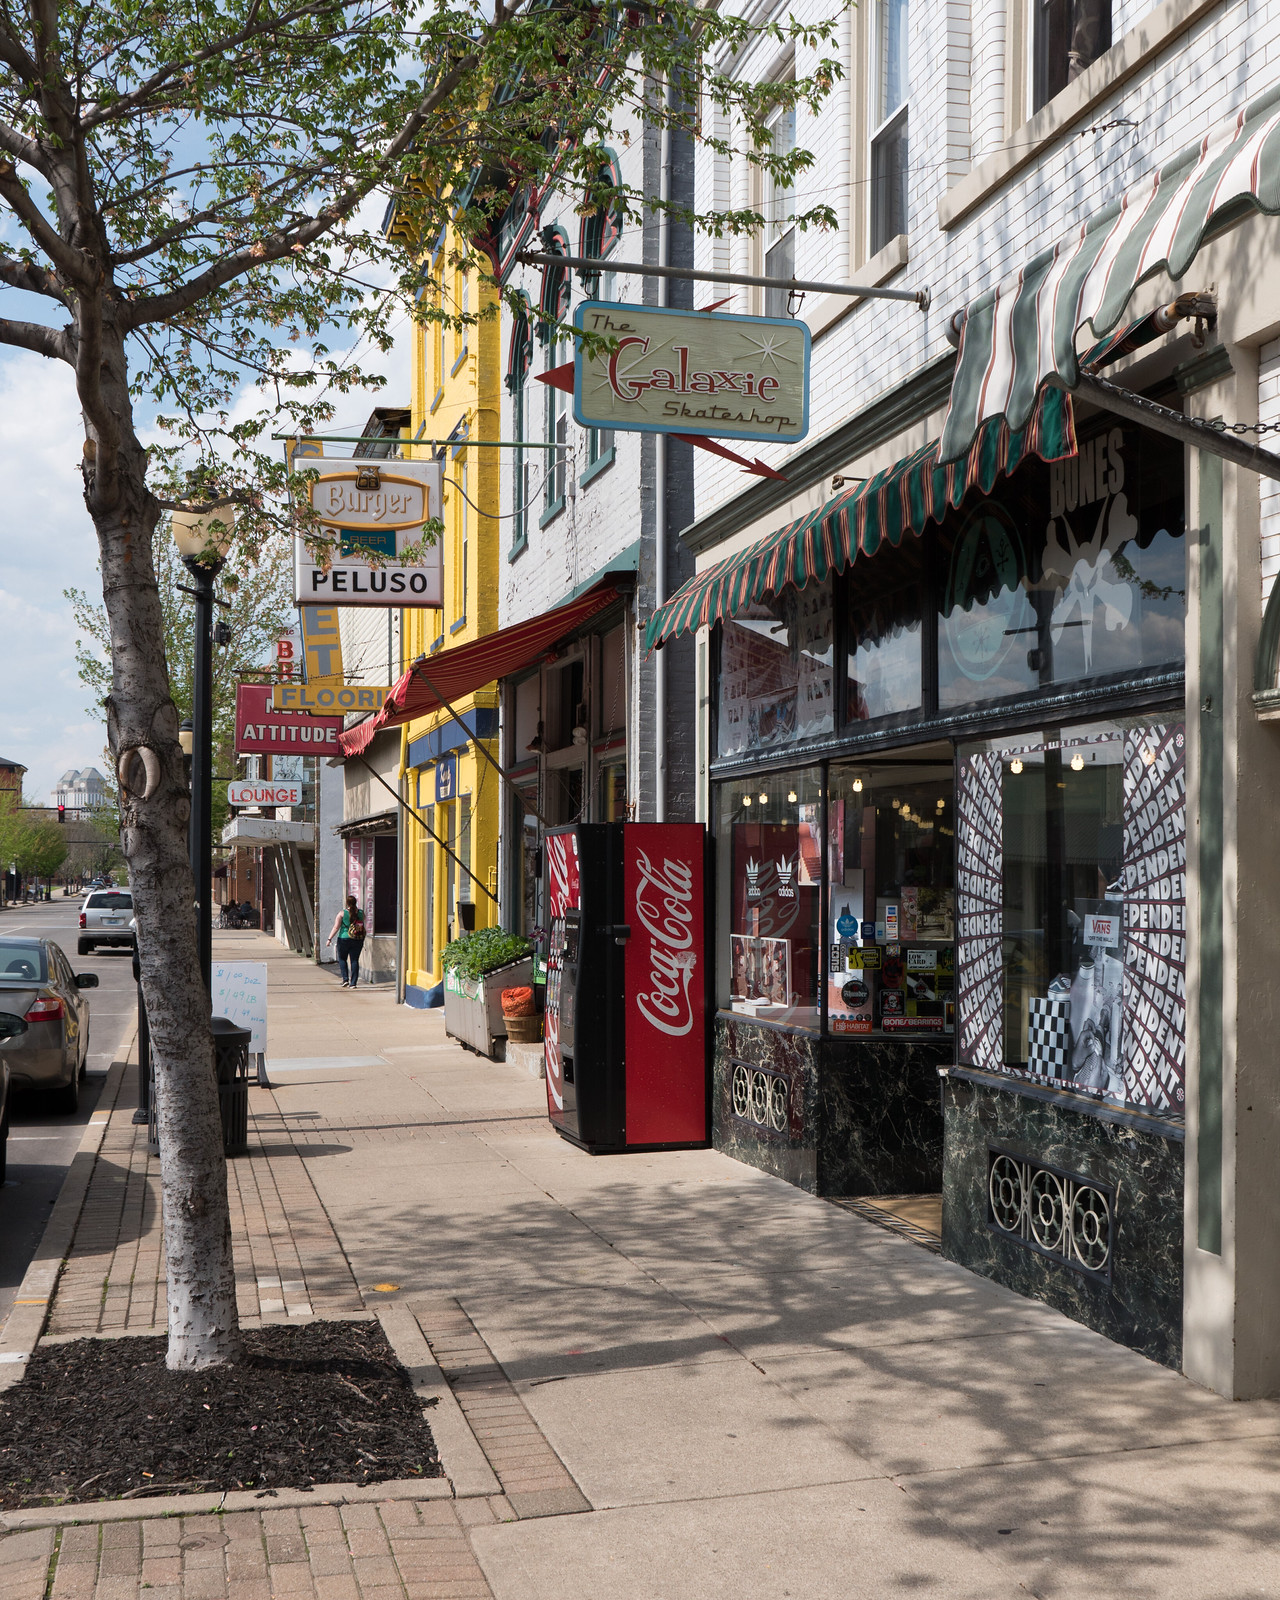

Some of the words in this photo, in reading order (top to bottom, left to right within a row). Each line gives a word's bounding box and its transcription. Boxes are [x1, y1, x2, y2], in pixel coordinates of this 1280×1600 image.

[591, 314, 636, 332] The
[607, 336, 780, 403] Galaxie
[662, 401, 797, 432] Skateshop
[1050, 427, 1126, 519] BONES
[326, 485, 413, 521] Burger
[350, 535, 387, 545] BEER
[312, 570, 428, 594] PELUSO
[242, 723, 338, 744] ATTITUDE
[231, 788, 299, 803] LOUNGE
[1092, 919, 1112, 935] VANS
[636, 846, 693, 1037] Coca-Cola
[846, 1022, 870, 1031] HABITAT
[908, 1018, 942, 1026] BEARINGS
